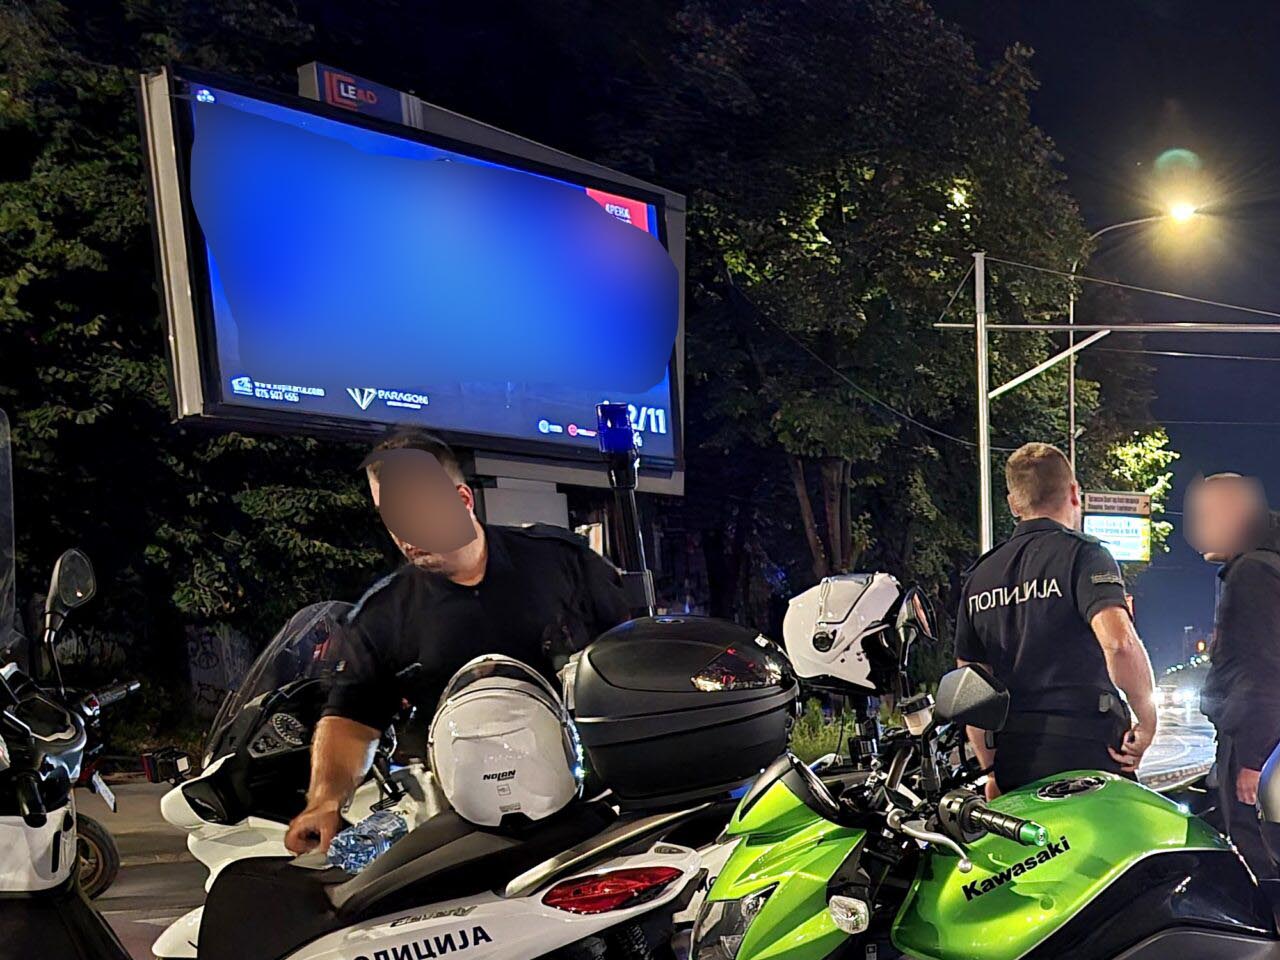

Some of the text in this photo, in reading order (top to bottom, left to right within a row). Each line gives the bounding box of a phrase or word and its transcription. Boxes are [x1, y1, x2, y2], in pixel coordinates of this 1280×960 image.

[968, 577, 1063, 616] ПОЛИЦИЈА
[482, 769, 517, 781] NOLAN
[961, 835, 1071, 902] Kawasaki
